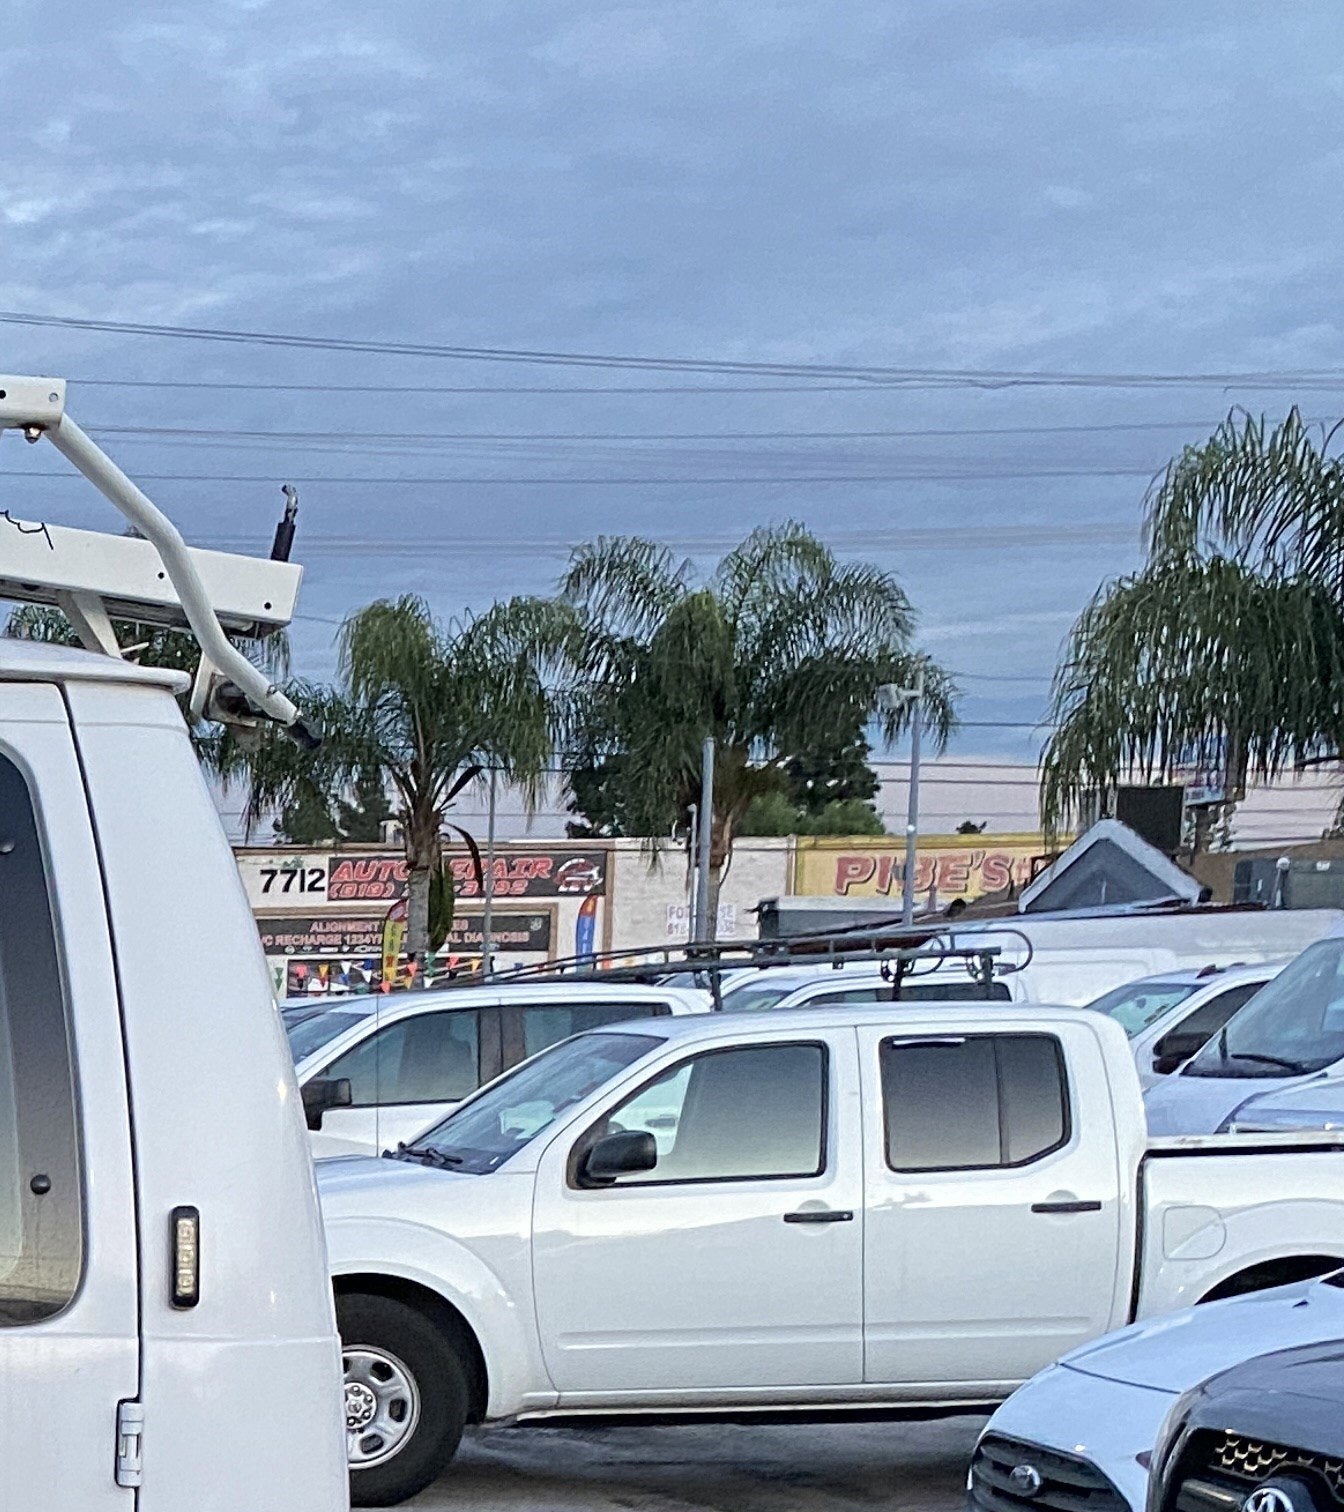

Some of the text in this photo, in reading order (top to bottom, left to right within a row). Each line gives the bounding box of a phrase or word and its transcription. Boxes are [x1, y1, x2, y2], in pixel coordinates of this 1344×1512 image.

[449, 857, 554, 880] EPAIR
[259, 867, 326, 894] 7712
[310, 920, 380, 933] ALIGNMENT
[274, 933, 343, 947] RECHARGE
[464, 930, 529, 943] DIANOSIS
